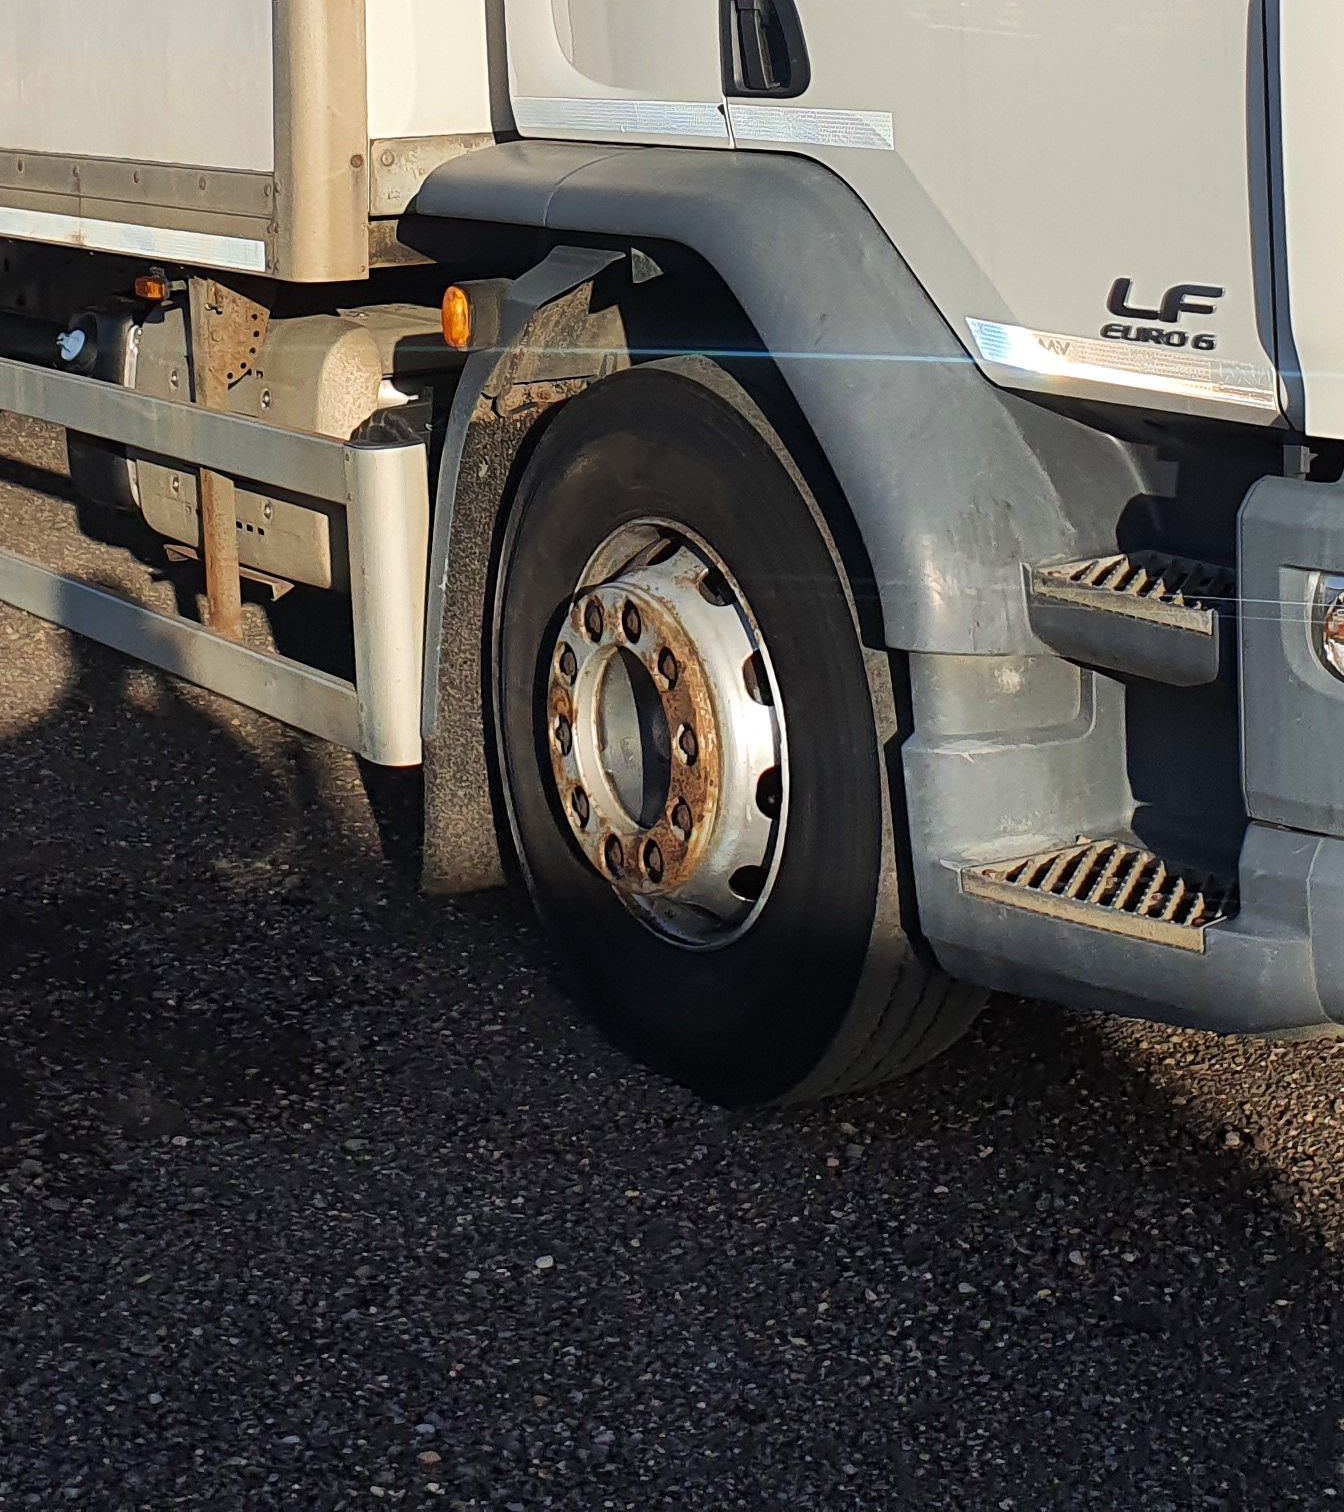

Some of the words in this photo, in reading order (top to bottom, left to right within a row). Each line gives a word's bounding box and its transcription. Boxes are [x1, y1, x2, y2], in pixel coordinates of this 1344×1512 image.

[1106, 277, 1226, 323] LF
[1100, 323, 1189, 348] EURO
[1191, 333, 1217, 351] 6
